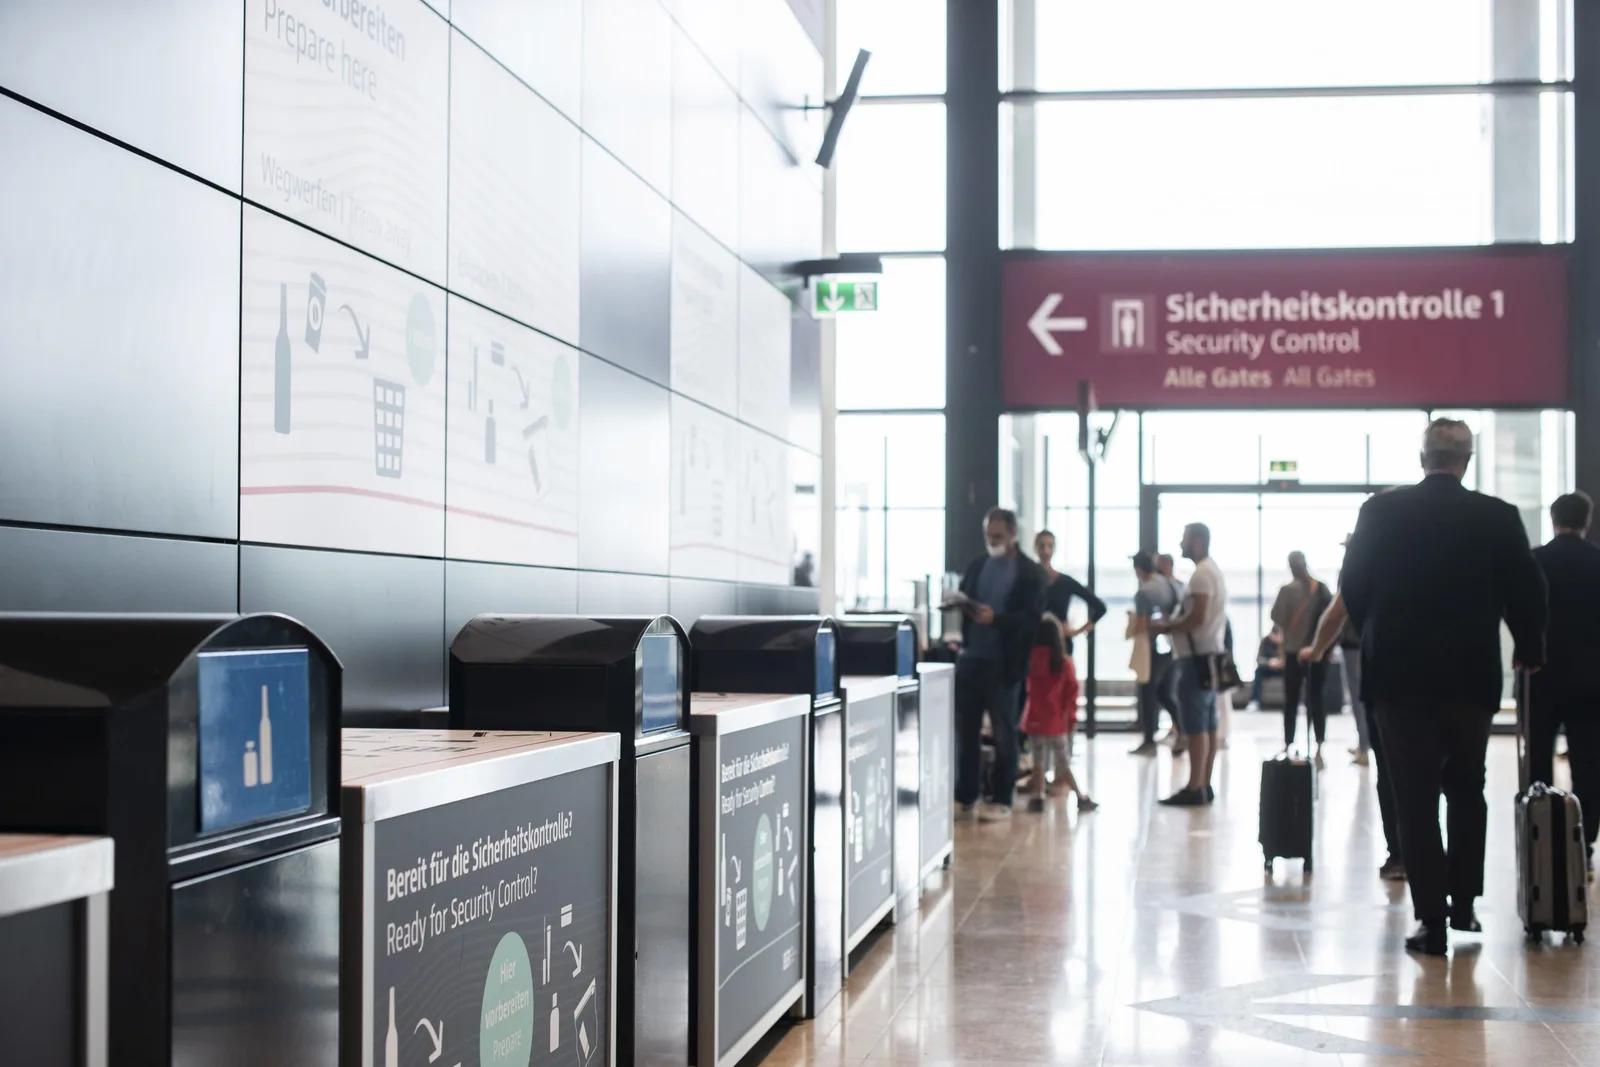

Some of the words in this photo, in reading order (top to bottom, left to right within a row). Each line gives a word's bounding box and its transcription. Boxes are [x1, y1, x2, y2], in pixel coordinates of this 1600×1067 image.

[264, 0, 335, 73] Prepare
[342, 37, 377, 101] here
[261, 152, 337, 216] Wegwerfen
[1166, 288, 1483, 323] Sicherheitskontrolle
[1490, 289, 1506, 318] 1
[1165, 328, 1265, 360] Security
[1270, 327, 1361, 354] Control
[1163, 366, 1207, 388] Alle
[1211, 367, 1272, 389] Gates
[1283, 365, 1311, 388] All
[1316, 365, 1377, 389] Gates
[387, 856, 427, 902] Bereit
[430, 850, 450, 887] für
[452, 844, 470, 879] die
[472, 811, 573, 872] Sicherheitskontrolle?
[386, 910, 427, 957] Ready
[430, 903, 448, 937] for
[451, 885, 496, 929] Security
[498, 866, 538, 909] Control?
[500, 957, 517, 985] Hier
[485, 990, 529, 1030] vorbereiten
[493, 1029, 523, 1063] Prepare
